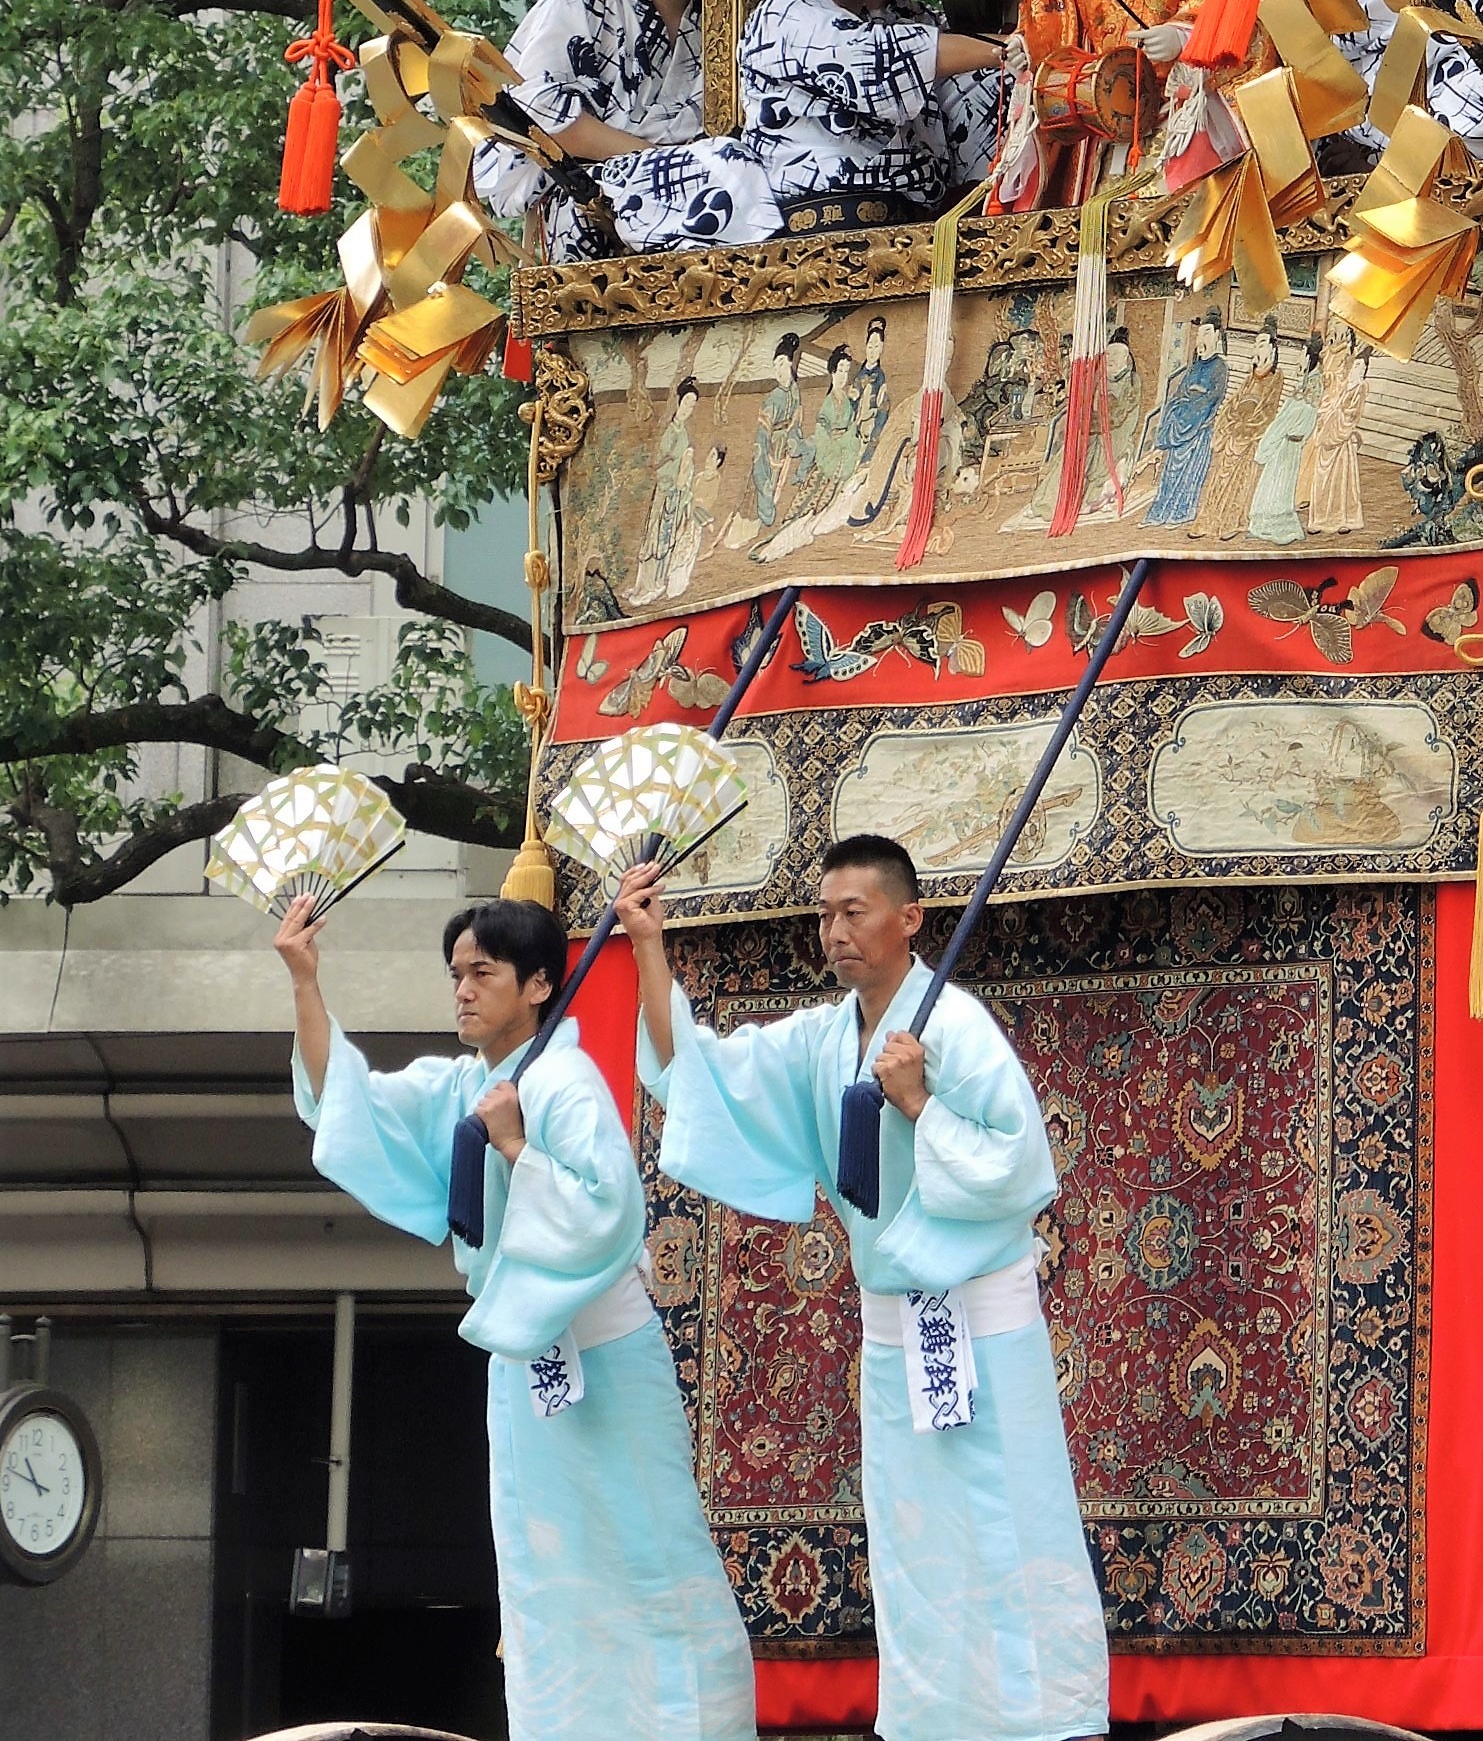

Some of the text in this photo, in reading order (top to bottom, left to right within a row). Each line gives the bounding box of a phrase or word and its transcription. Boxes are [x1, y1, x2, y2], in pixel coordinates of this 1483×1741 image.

[918, 1317, 957, 1397] 鶏鉾
[32, 1429, 43, 1447] 12
[59, 1453, 66, 1471] 2
[2, 1474, 10, 1492] 9
[62, 1476, 70, 1495] 3
[6, 1501, 15, 1519] 8
[57, 1503, 65, 1517] 4
[17, 1518, 25, 1536] 7
[31, 1524, 39, 1542] 6
[45, 1519, 54, 1537] 5
